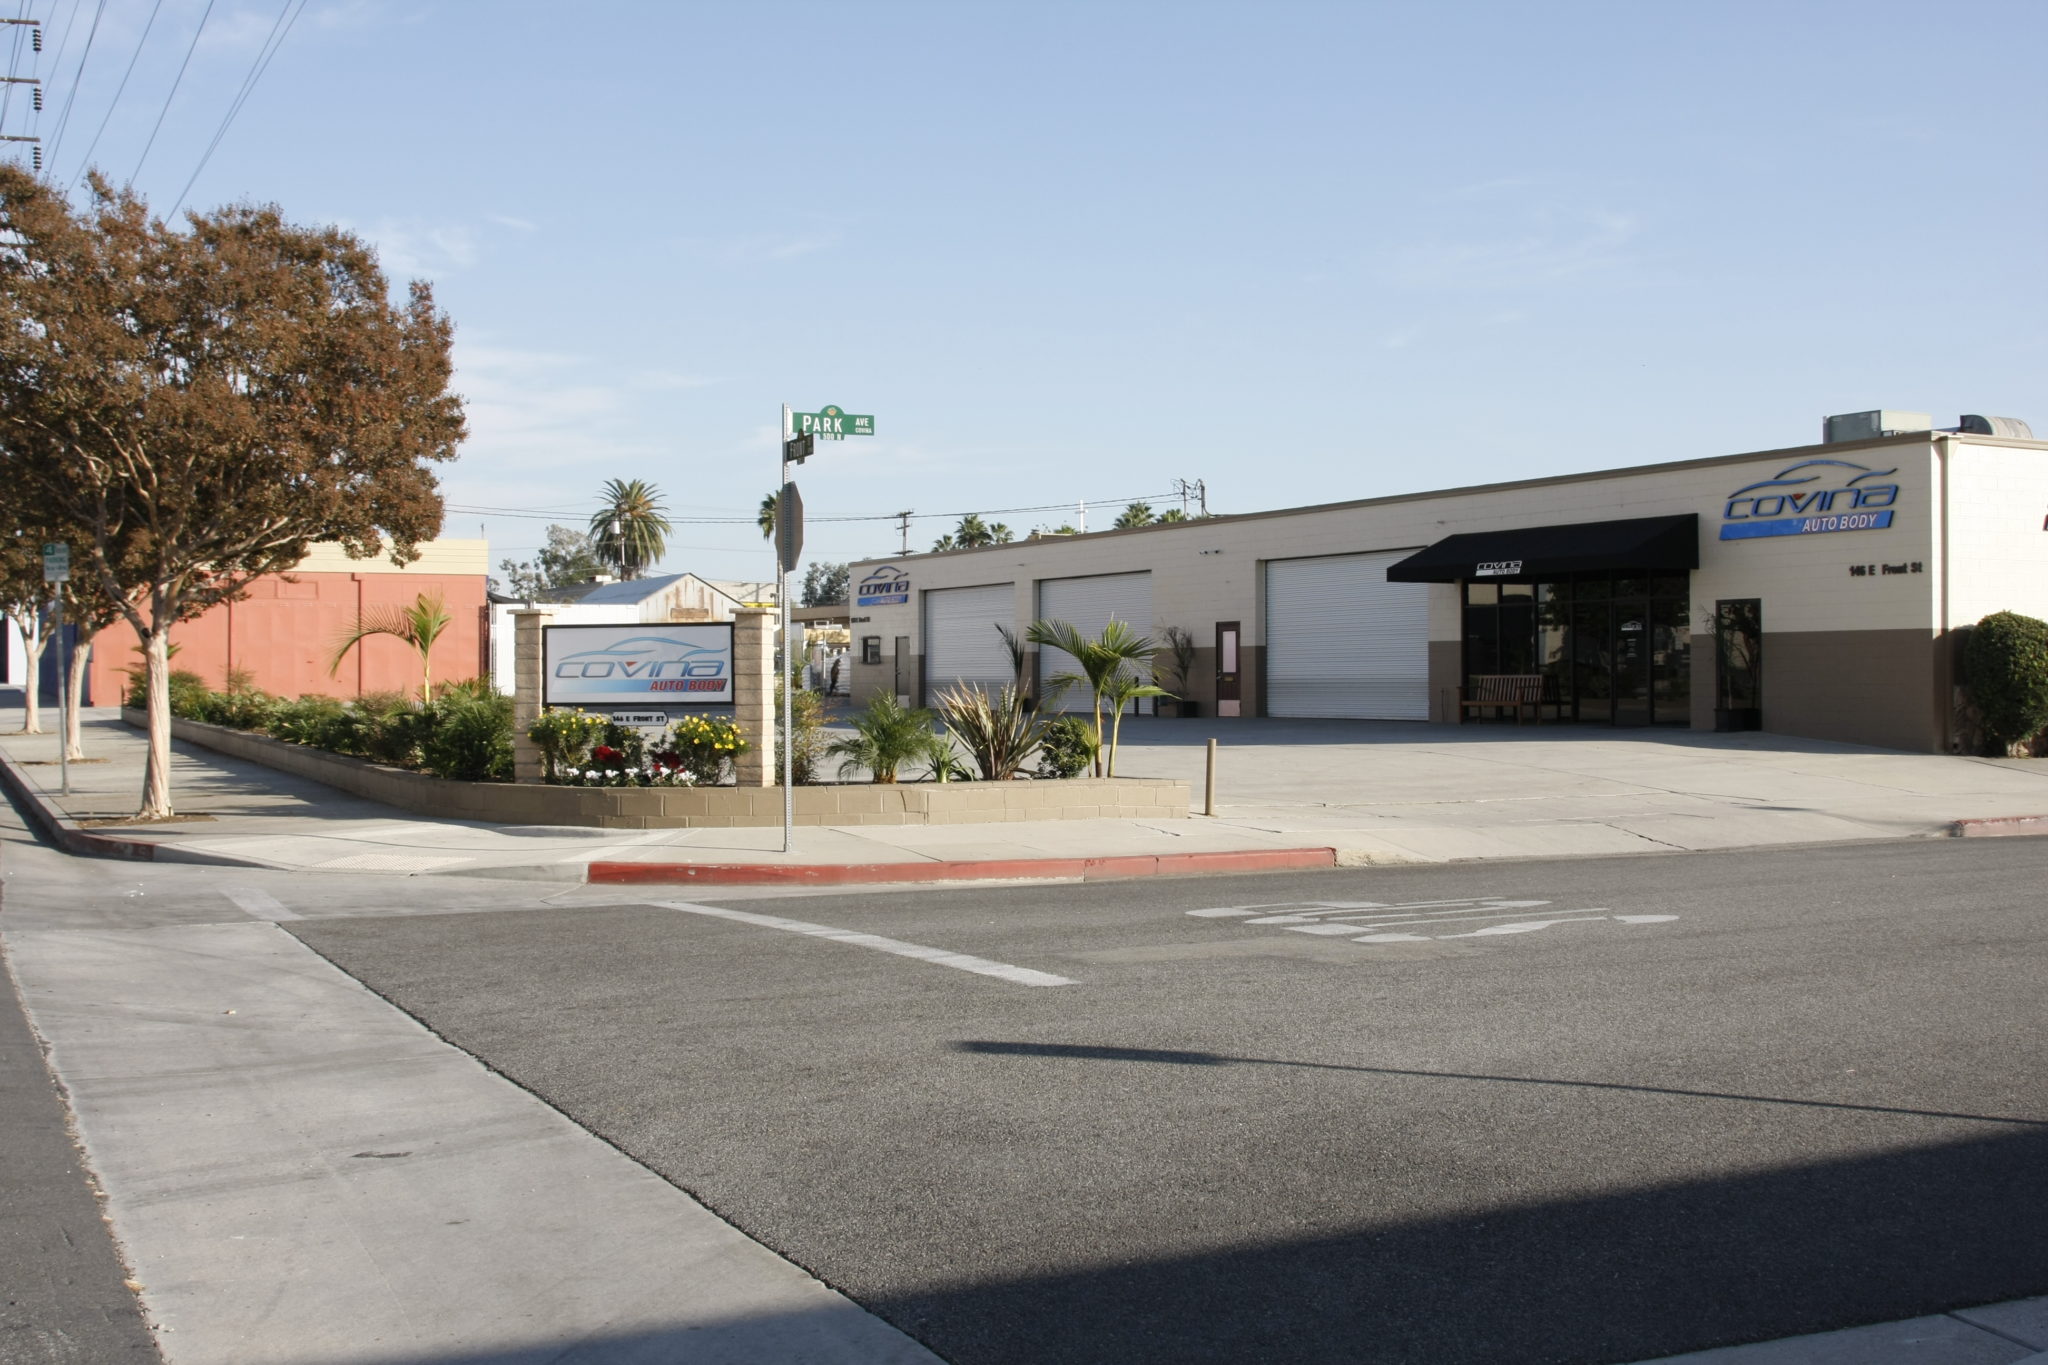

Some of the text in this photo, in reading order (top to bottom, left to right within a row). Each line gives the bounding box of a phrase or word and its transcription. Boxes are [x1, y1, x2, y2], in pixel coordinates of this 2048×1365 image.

[803, 415, 868, 432] PARK AVE
[1802, 513, 1878, 533] AUTO BODY
[1868, 565, 1875, 575] E
[1882, 563, 1907, 575] Front
[1911, 562, 1922, 573] St
[650, 680, 724, 690] AUTO BODY
